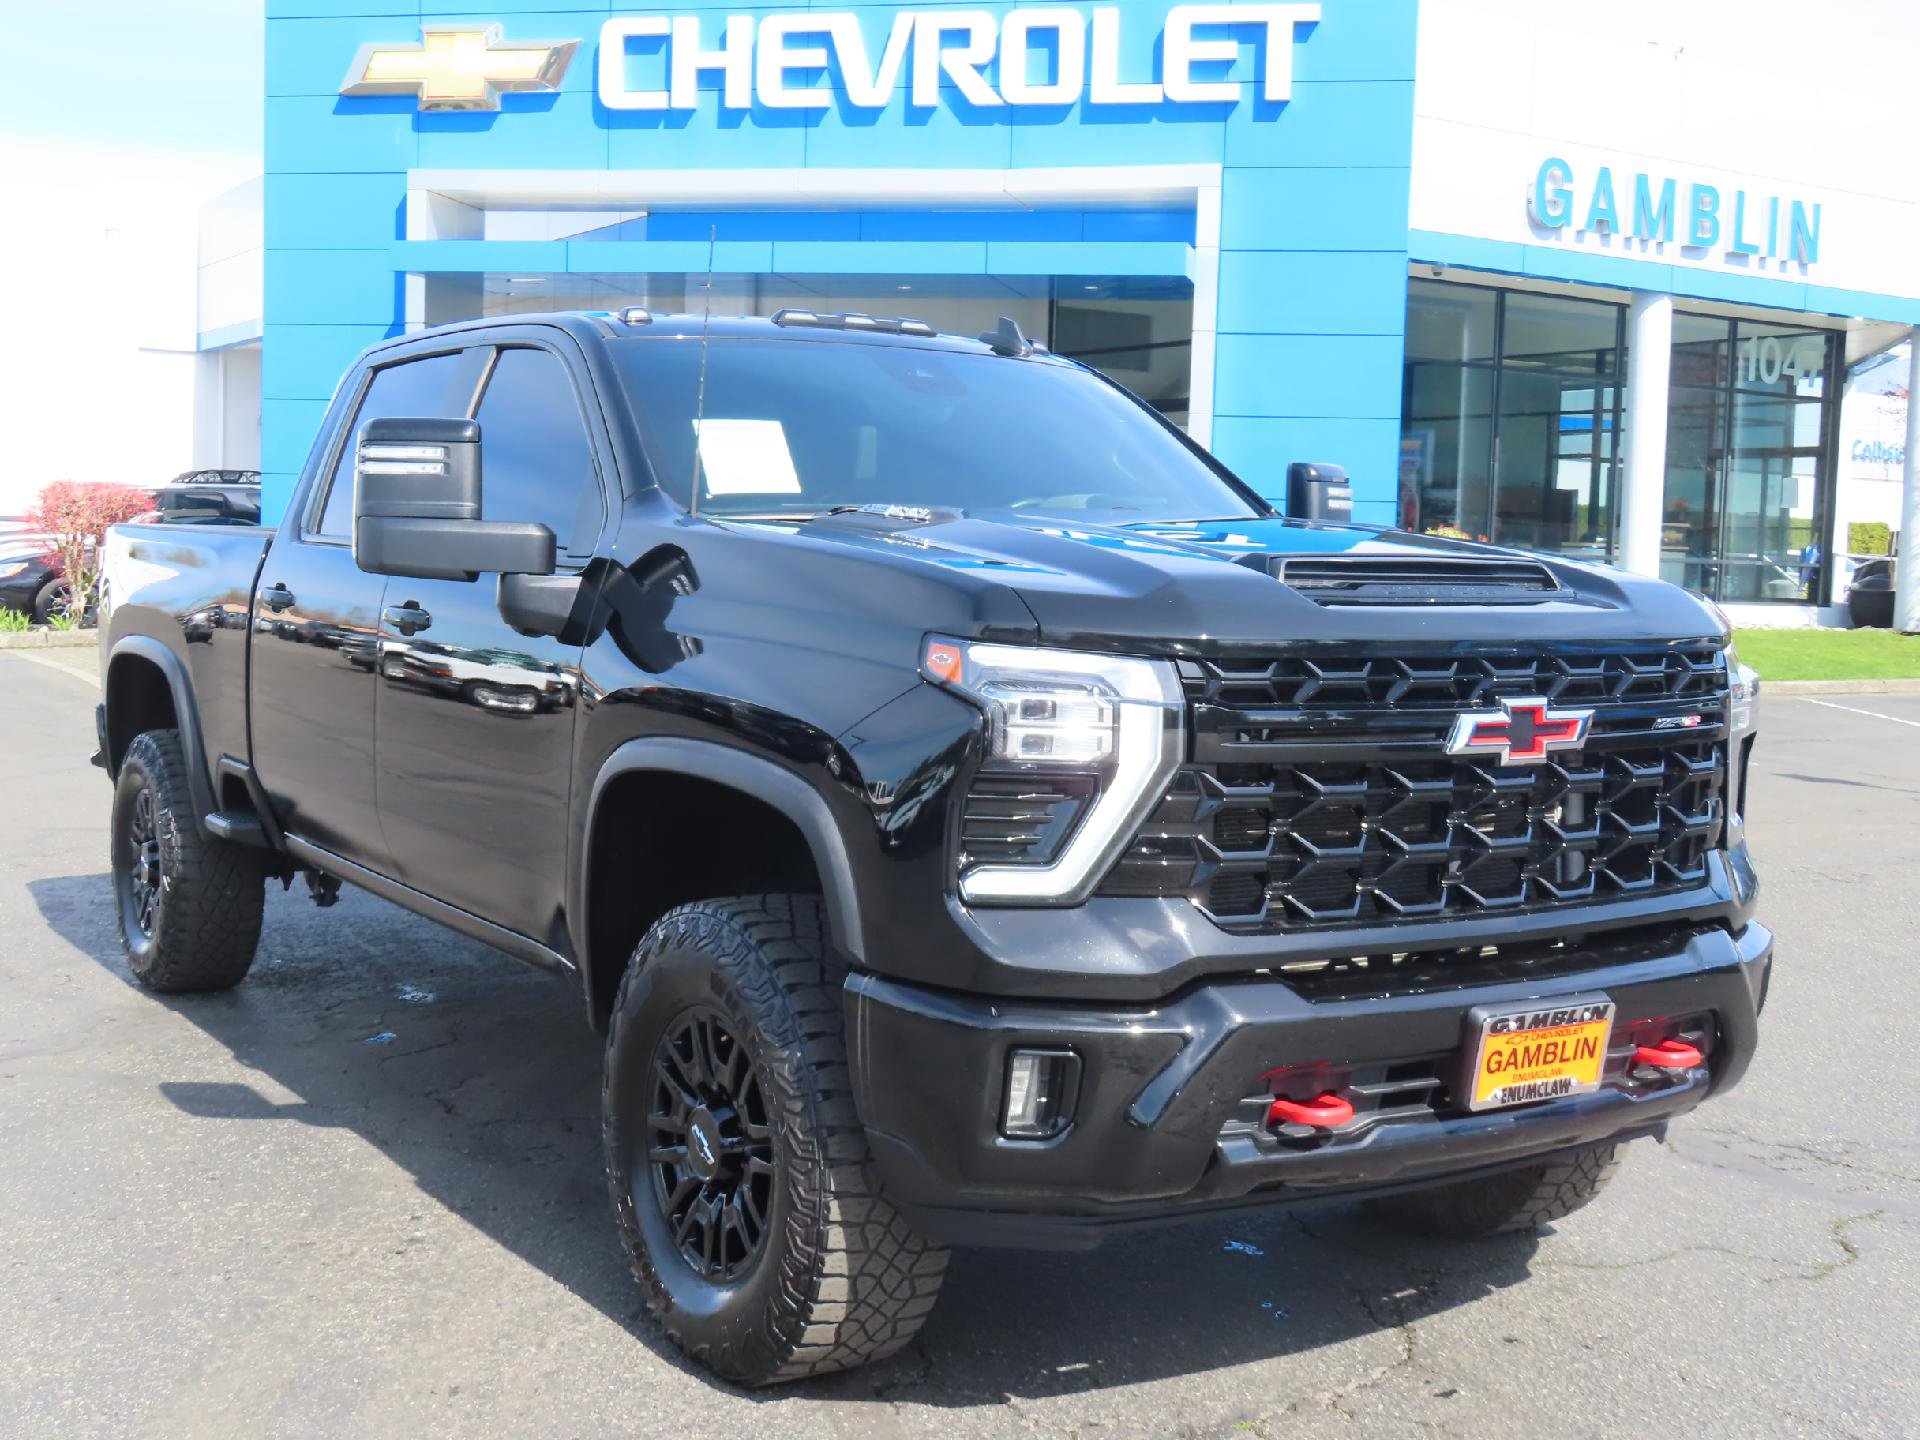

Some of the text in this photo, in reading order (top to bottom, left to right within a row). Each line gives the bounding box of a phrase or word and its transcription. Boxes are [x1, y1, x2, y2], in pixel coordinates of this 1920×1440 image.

[598, 3, 1321, 110] CHEVROLET
[1533, 157, 1821, 264] GAMBLIN
[1490, 1005, 1609, 1033] GAMBLIN
[1530, 1026, 1584, 1040] CHEVROLET
[1486, 1037, 1599, 1074] GAMBLIN
[1512, 1068, 1564, 1082] ENUMCLAW
[1501, 1078, 1571, 1104] ENUMCLAW
